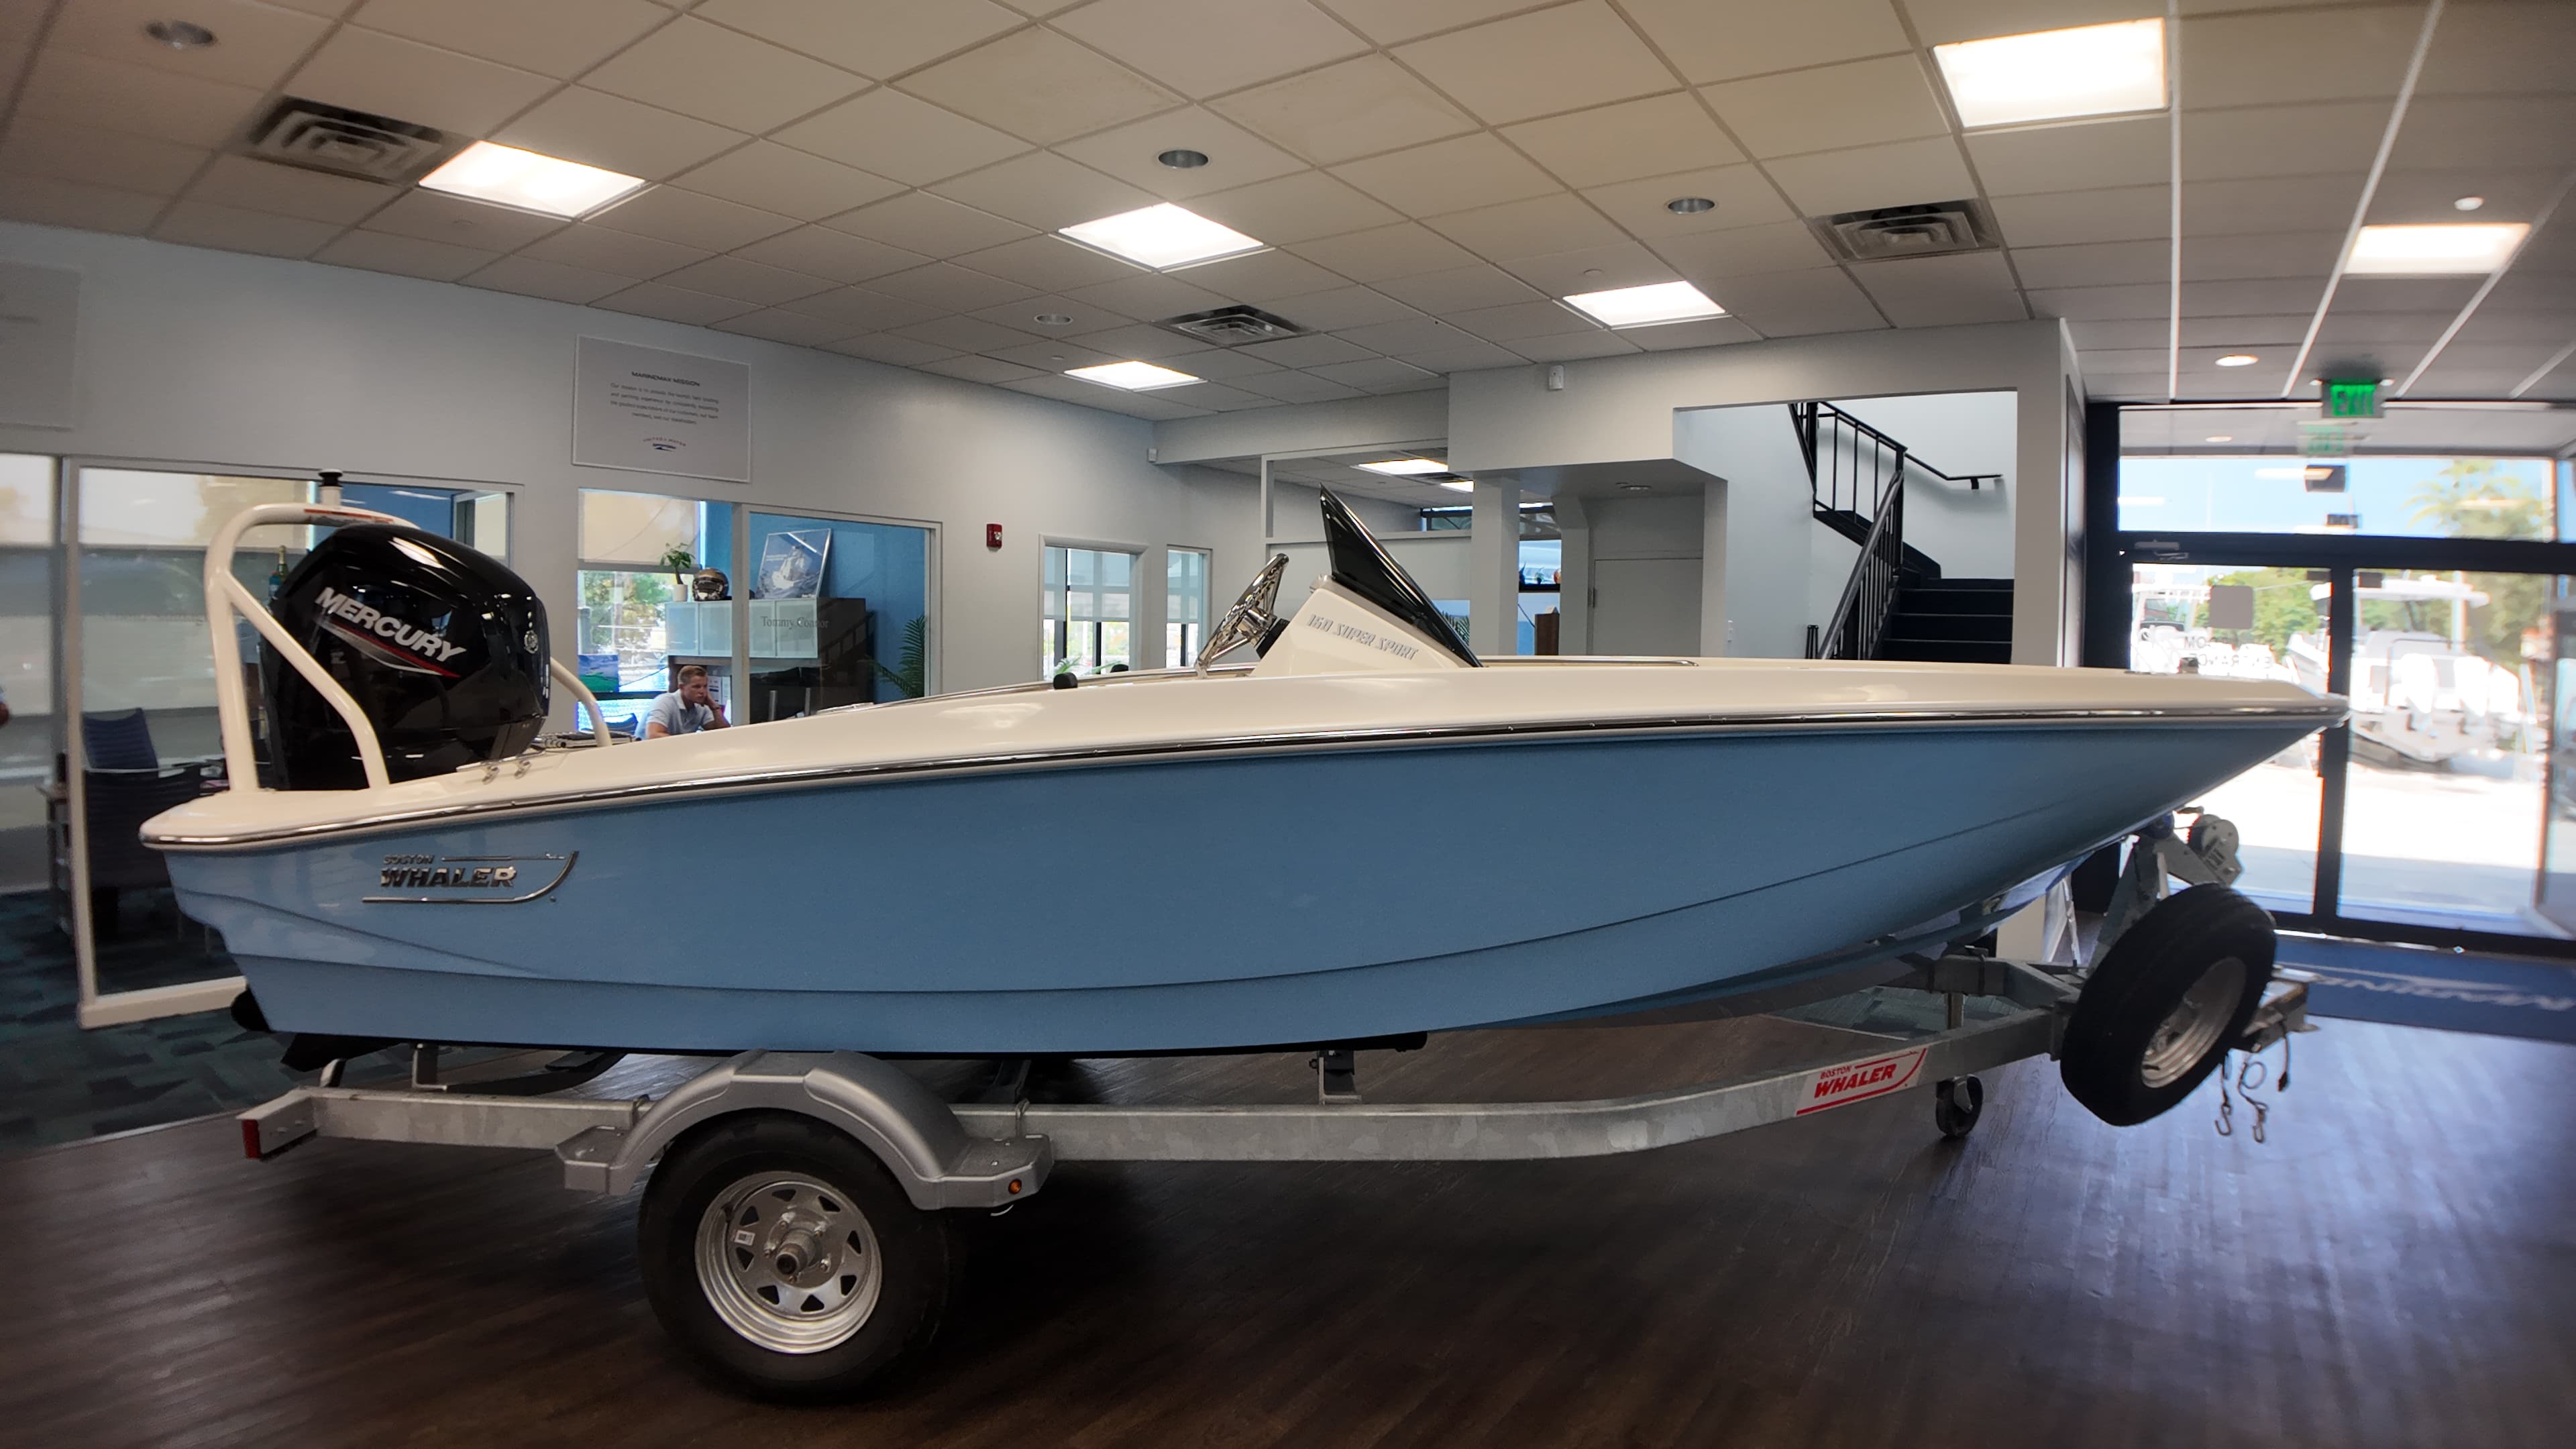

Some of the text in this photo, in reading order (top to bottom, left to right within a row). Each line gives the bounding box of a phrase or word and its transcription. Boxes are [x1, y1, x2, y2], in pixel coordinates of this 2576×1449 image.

[2330, 384, 2377, 417] EXIT
[315, 586, 467, 663] MERCURY
[762, 616, 794, 629] Tommy
[1308, 614, 1419, 660] 160 SUPER SPORT
[380, 865, 517, 888] WHALER
[1813, 1063, 1898, 1099] WHALER
[1819, 1065, 1853, 1080] BOSTON
